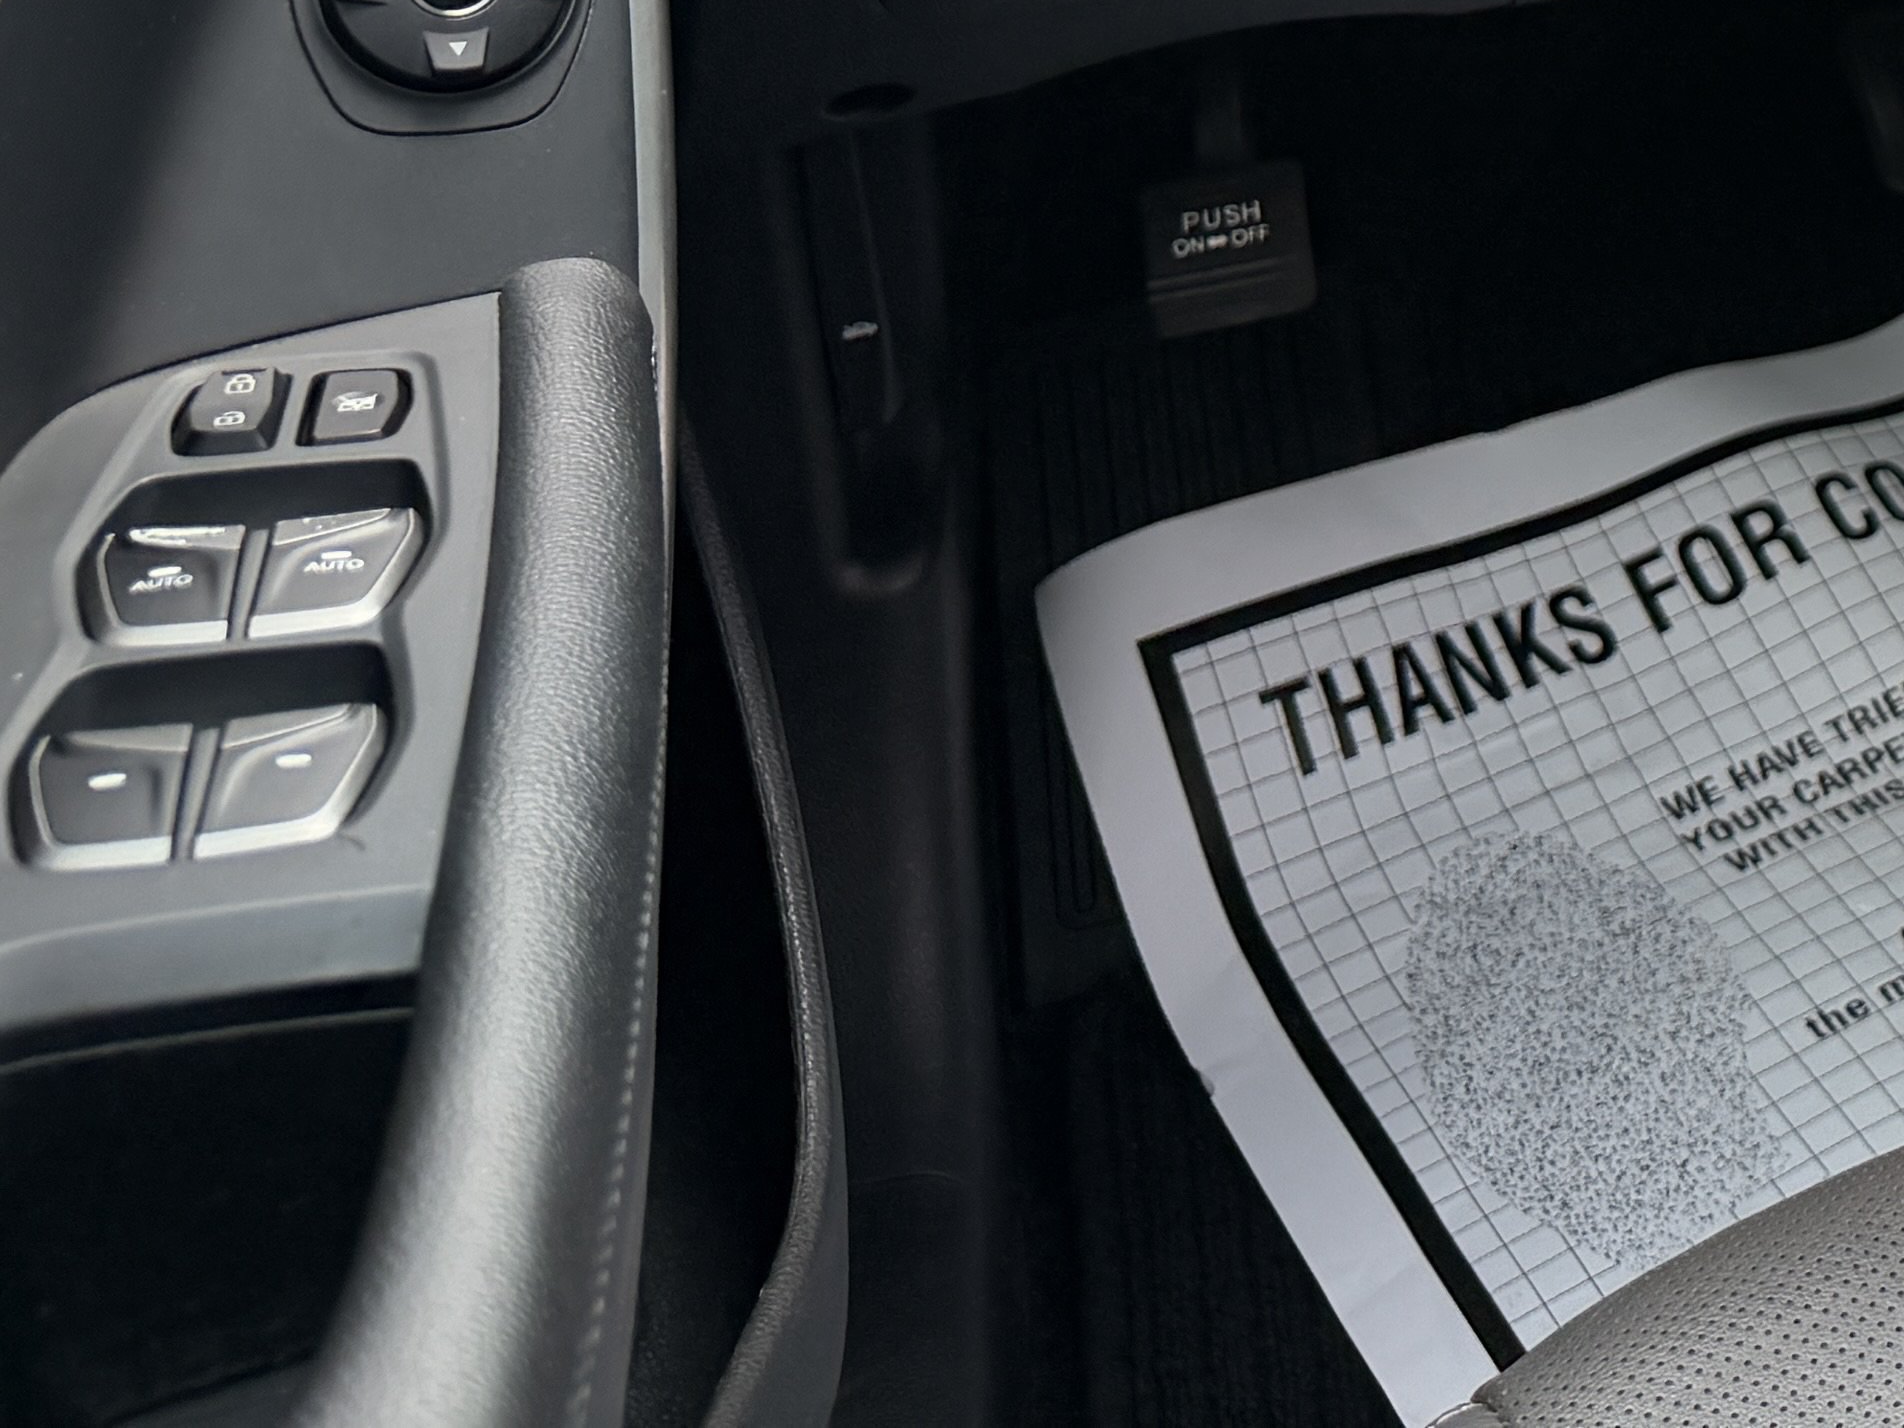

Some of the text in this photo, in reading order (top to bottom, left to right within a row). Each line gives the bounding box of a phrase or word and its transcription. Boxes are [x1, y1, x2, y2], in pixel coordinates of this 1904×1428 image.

[1181, 199, 1263, 235] PUSH
[1170, 223, 1271, 260] ON OFF
[128, 570, 195, 595] AUTO
[303, 555, 366, 575] AUTO
[1257, 582, 1621, 779] THANKS
[1626, 498, 1812, 636] FOR
[1659, 772, 1721, 822] WE
[1728, 732, 1828, 792] HAVE
[1680, 799, 1789, 853] YOUR
[1721, 818, 1825, 875] WITH
[1804, 994, 1871, 1042] the
